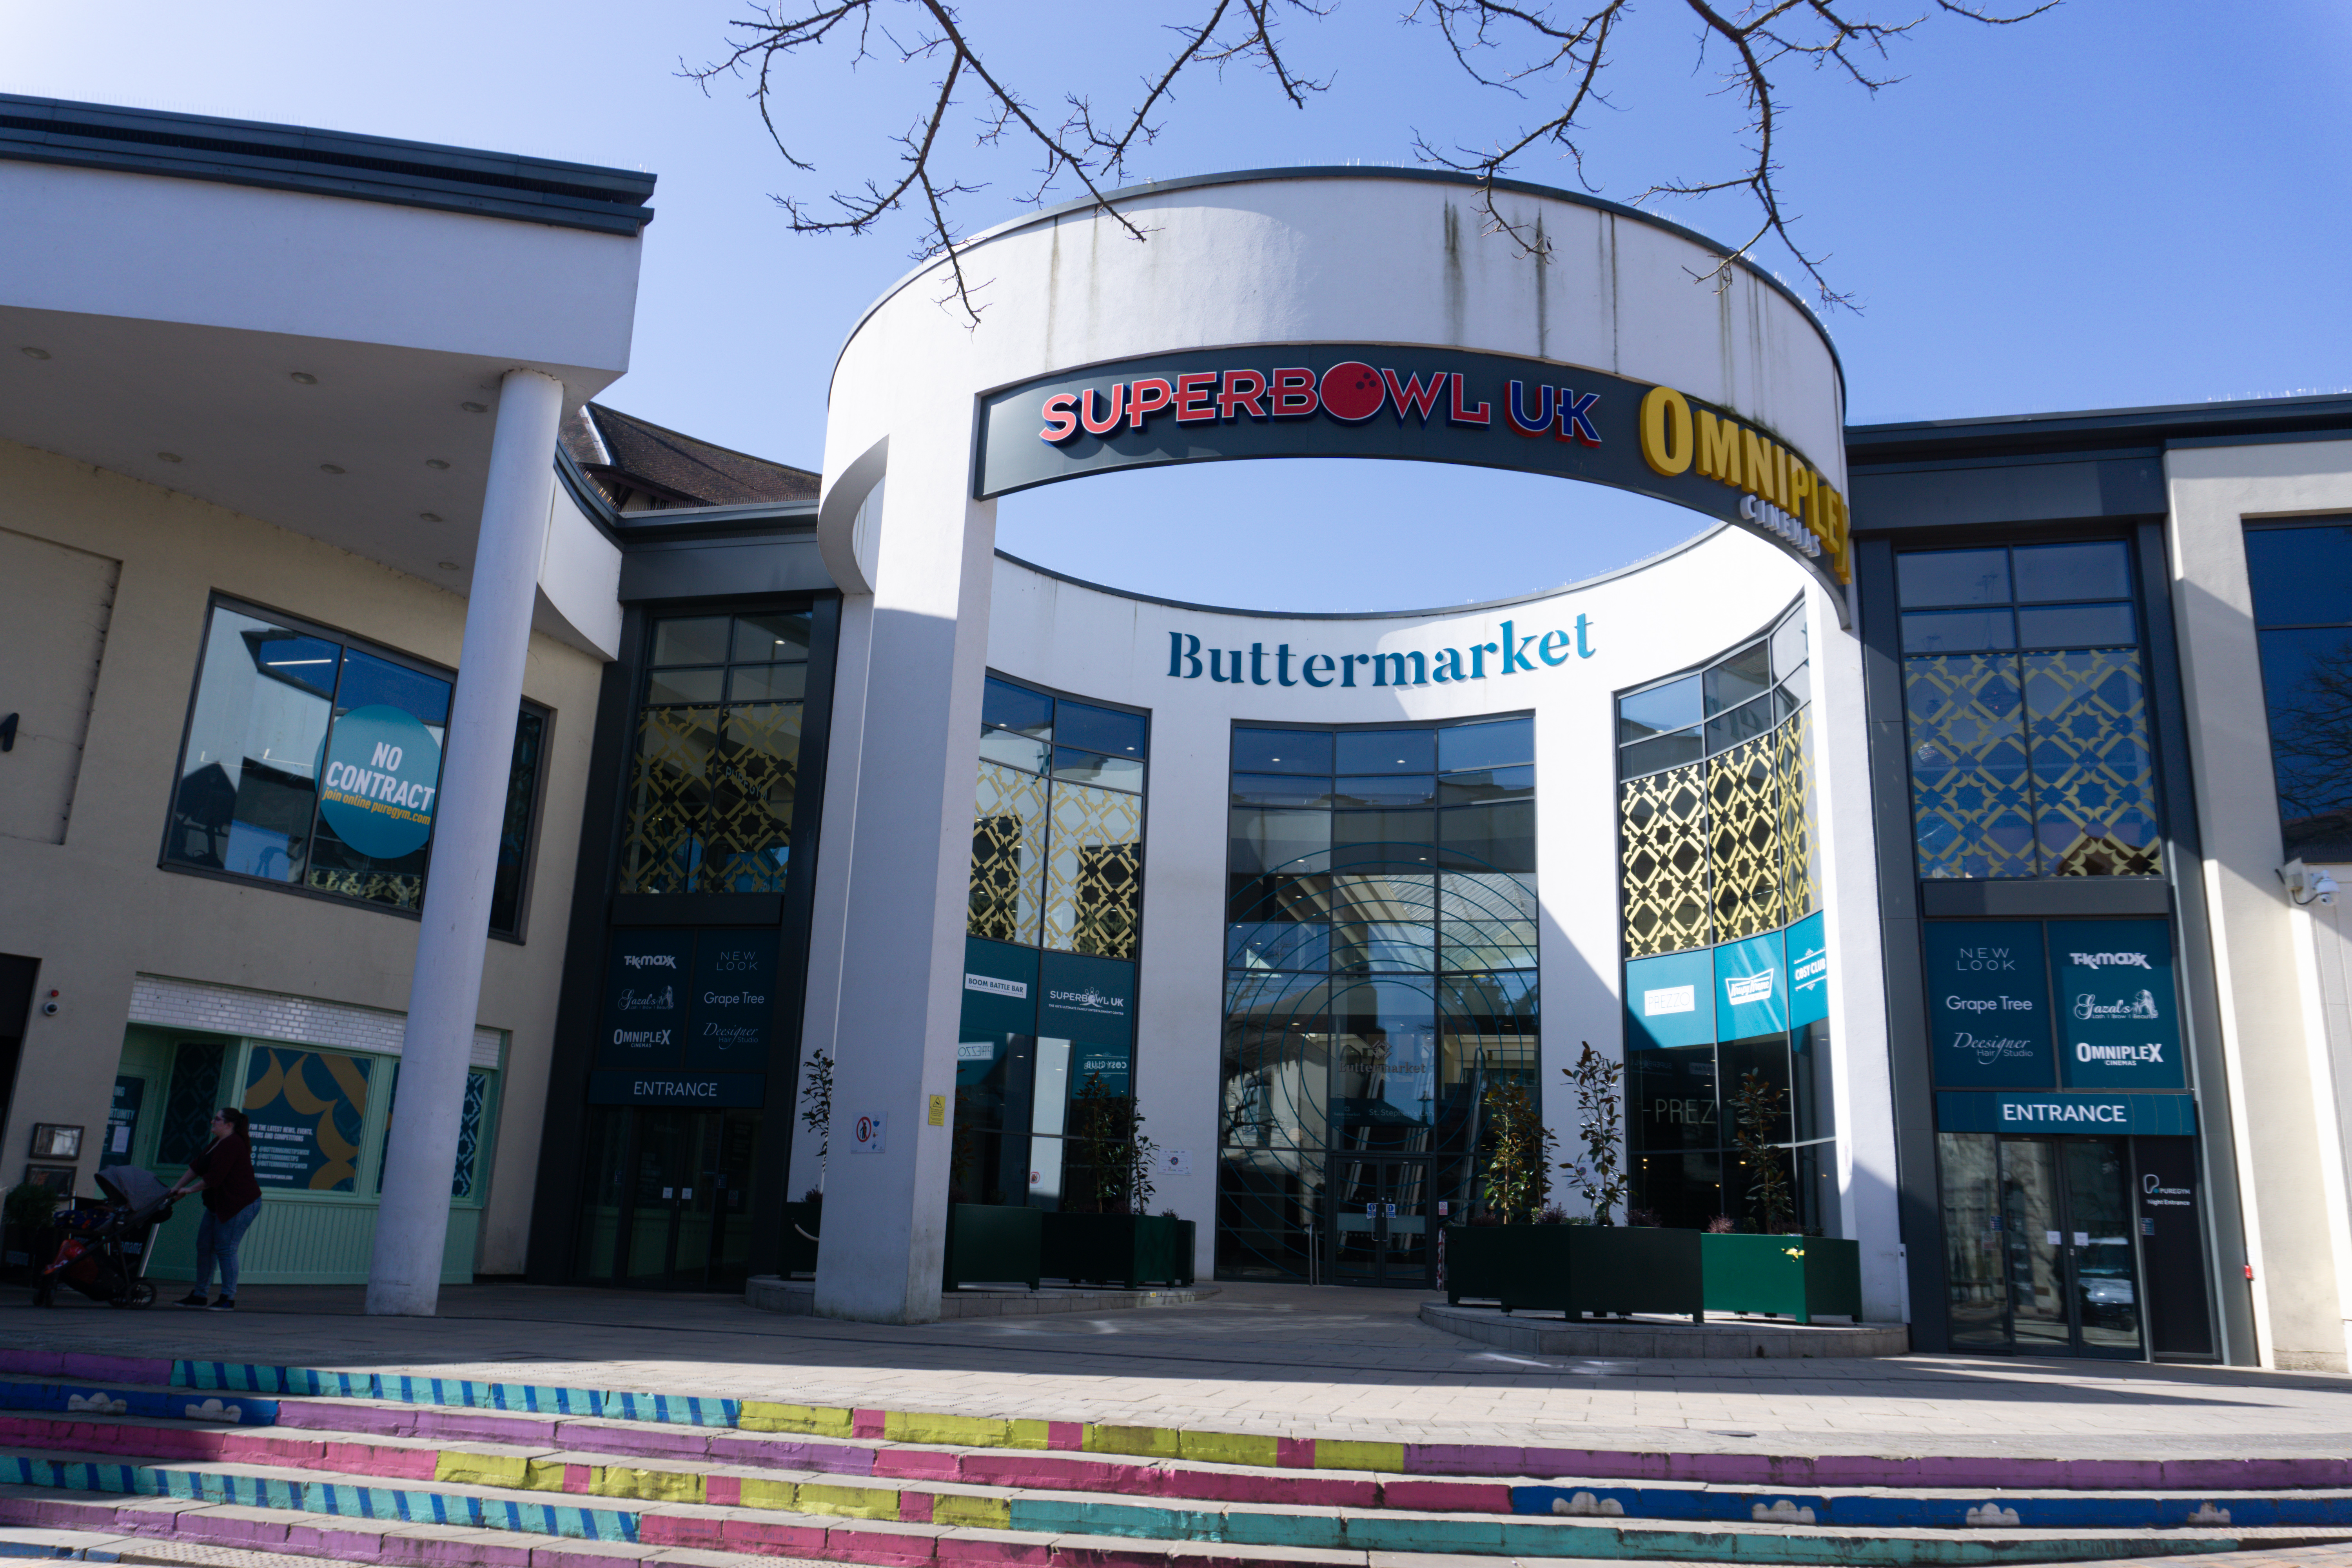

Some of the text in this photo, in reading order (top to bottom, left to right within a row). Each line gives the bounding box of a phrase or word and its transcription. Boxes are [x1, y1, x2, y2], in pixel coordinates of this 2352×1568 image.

[1038, 361, 1602, 447] SUPERBOWL UK
[1640, 386, 1852, 584] OMNIPLEX
[1740, 495, 1821, 557] CINEMAS
[1167, 613, 1596, 687] Buttermarket
[371, 742, 403, 771] NO
[326, 761, 435, 811] CONTRACT
[322, 787, 431, 825] join online puregym.com
[720, 951, 755, 960] NEW
[1960, 948, 2009, 958] NEW
[717, 962, 758, 971] LOOK
[1795, 958, 1826, 980] COSY CLUB
[1956, 960, 2015, 970] LOOK
[969, 978, 988, 987] BOOM
[990, 982, 1010, 991] BATTLE
[618, 989, 657, 1010] Gazal's
[704, 992, 764, 1007] Grape Tree
[1050, 990, 1124, 1007] SUPERBOWL UK
[1648, 992, 1691, 1010] PREZZO
[1945, 995, 2033, 1014] Grape Tree
[2073, 994, 2132, 1020] Gazal's
[613, 1029, 671, 1045] OMNIPLEX
[703, 1022, 758, 1050] Deesigner
[1953, 1032, 2031, 1065] Deesigner
[2076, 1042, 2164, 1062] OMNIPLEX
[1339, 1062, 1426, 1073] Buttermarket
[634, 1081, 717, 1096] ENTRANCE
[1381, 1109, 1418, 1118] Stephen's
[1656, 1099, 1717, 1124] PREZ
[2003, 1104, 2127, 1122] ENTRANCE
[274, 1133, 304, 1142] COMPETITIONS
